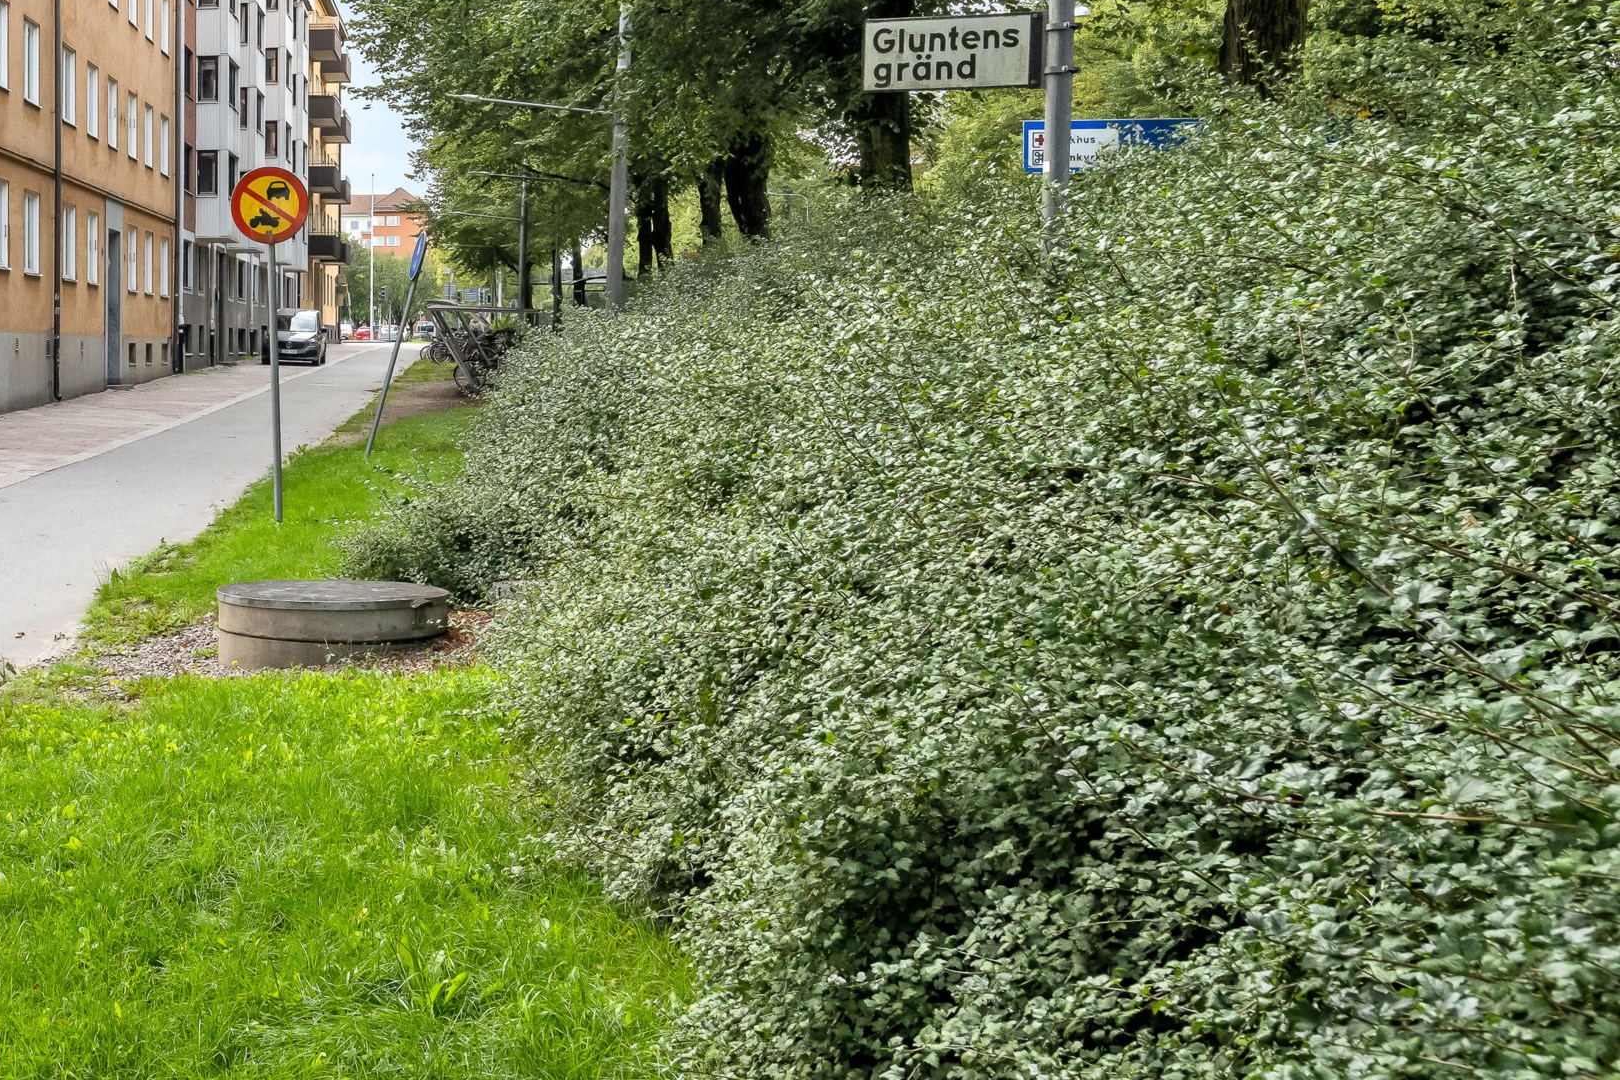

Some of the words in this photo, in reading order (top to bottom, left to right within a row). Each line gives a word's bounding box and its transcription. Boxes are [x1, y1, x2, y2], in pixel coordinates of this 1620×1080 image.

[873, 26, 1020, 54] Gluntens
[873, 53, 977, 88] gränd
[1069, 135, 1096, 144] khus
